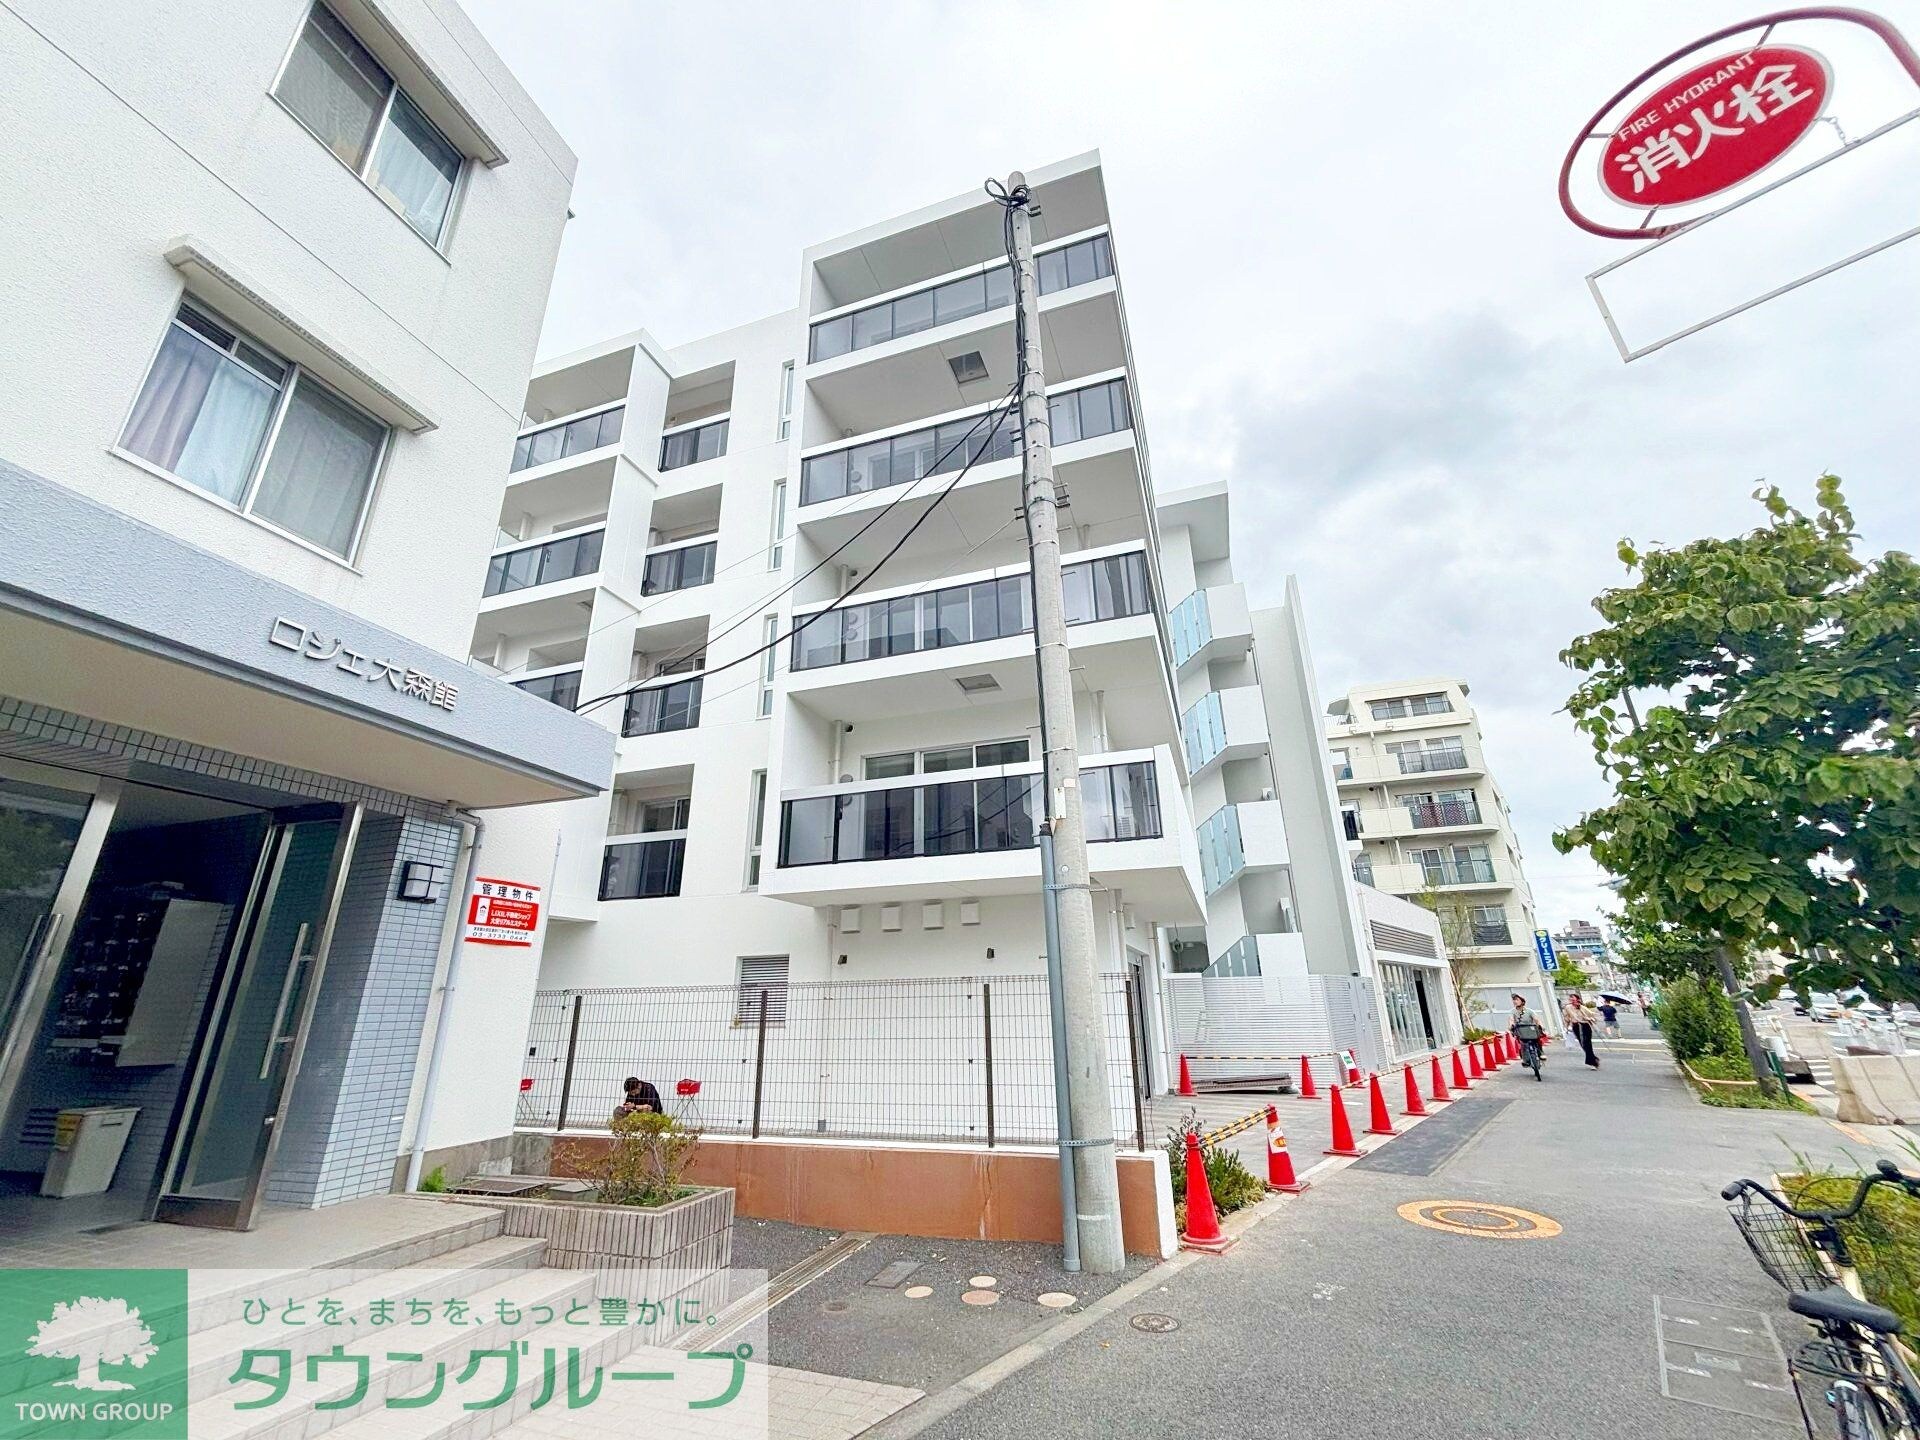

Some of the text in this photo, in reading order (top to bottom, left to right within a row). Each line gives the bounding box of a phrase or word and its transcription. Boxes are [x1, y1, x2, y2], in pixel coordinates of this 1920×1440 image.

[1614, 63, 1814, 194] 消火栓
[1619, 52, 1755, 142] FIRE HYDRANT
[269, 615, 460, 712] ロジェ大森館
[482, 884, 533, 901] 管理物件
